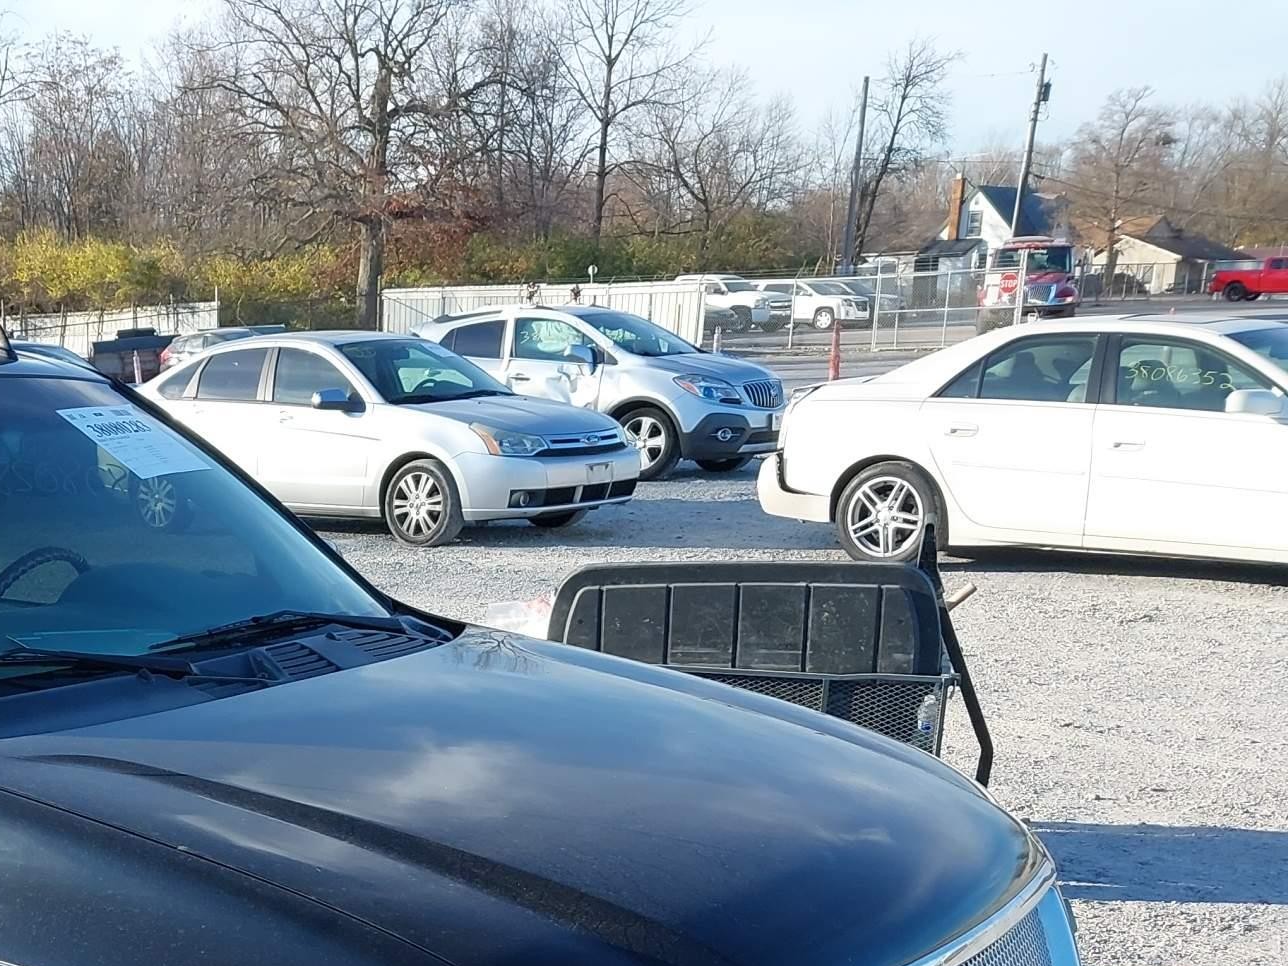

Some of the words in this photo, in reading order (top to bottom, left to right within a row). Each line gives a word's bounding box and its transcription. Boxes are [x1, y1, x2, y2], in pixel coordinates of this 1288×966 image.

[1000, 279, 1018, 288] STOP
[1124, 361, 1237, 391] 38086352
[86, 419, 152, 438] 38080283
